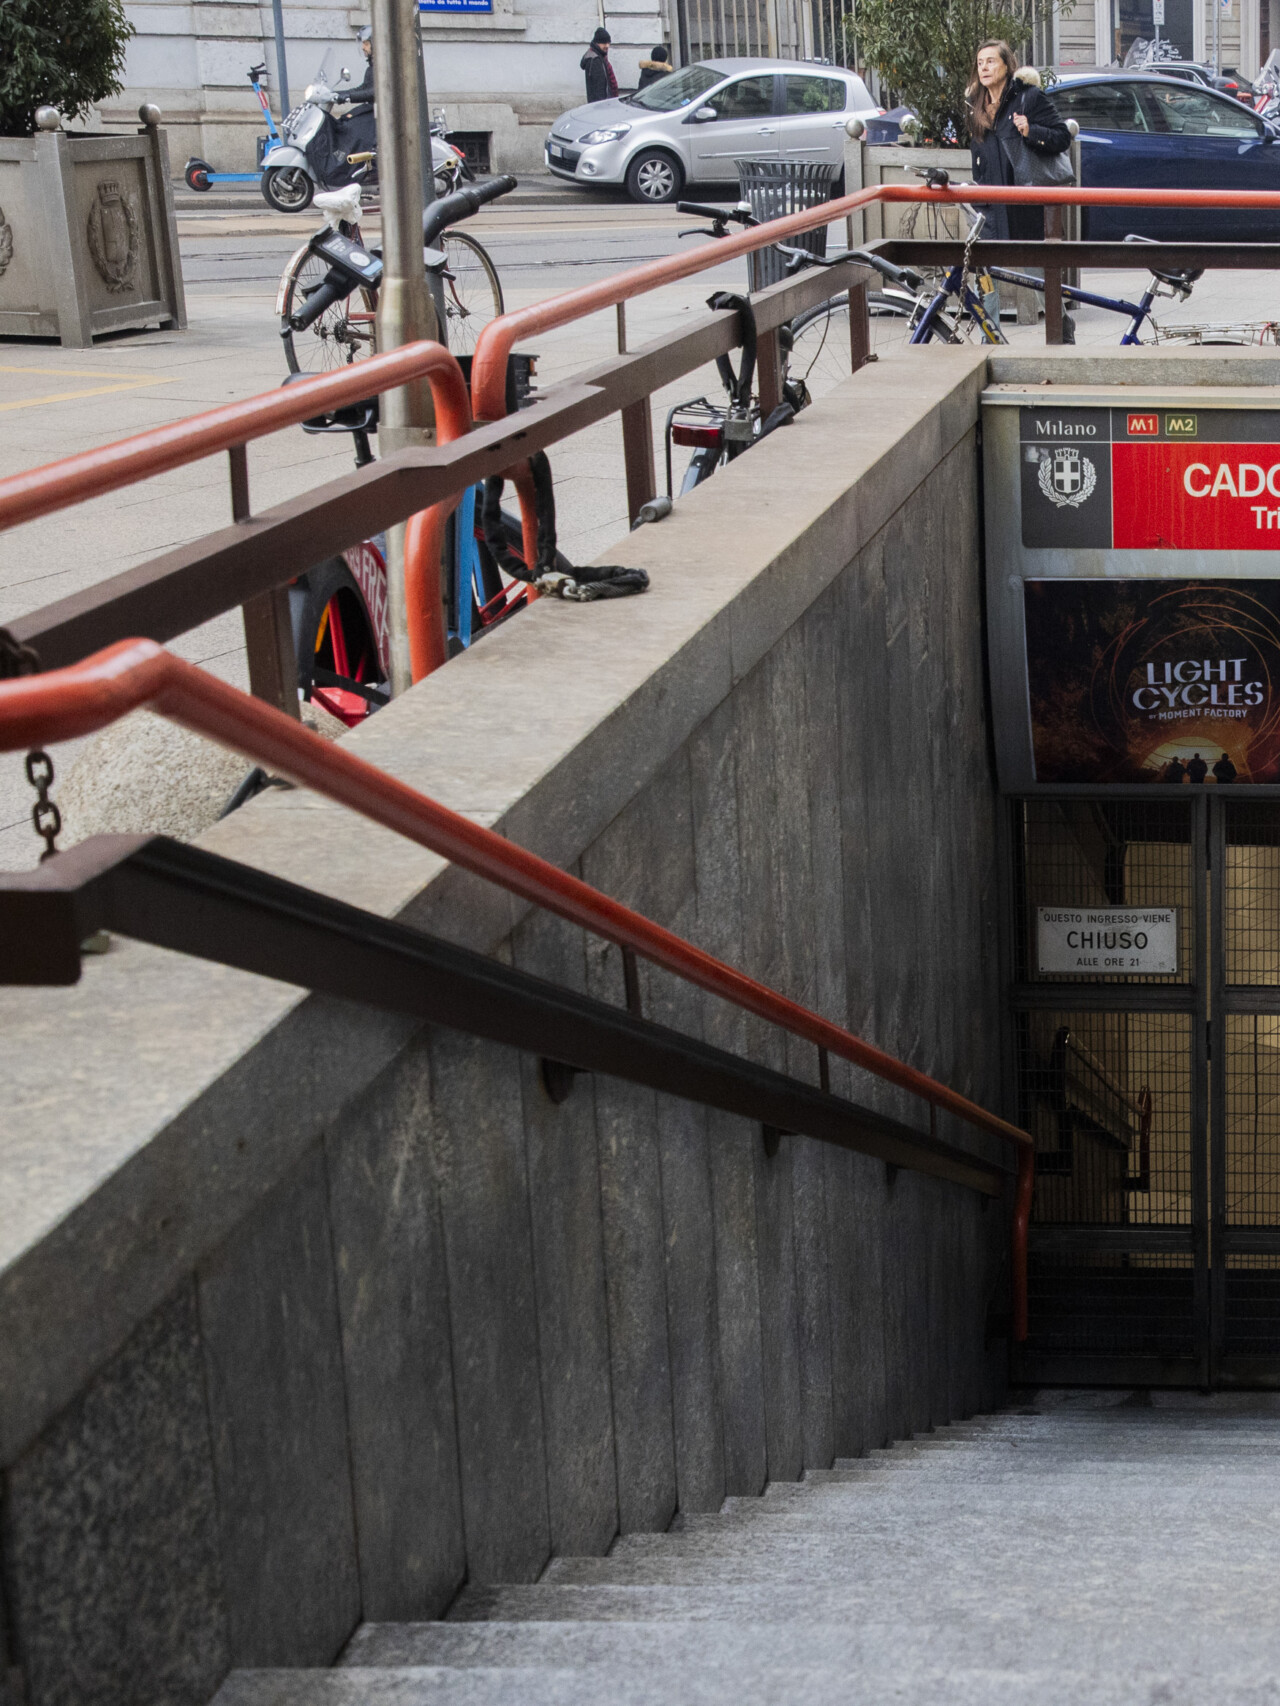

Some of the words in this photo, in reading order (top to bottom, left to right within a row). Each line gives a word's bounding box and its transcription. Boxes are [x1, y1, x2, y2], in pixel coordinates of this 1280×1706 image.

[1035, 420, 1097, 436] Milano
[1130, 418, 1154, 431] M1
[1168, 419, 1193, 431] M2
[1147, 658, 1247, 685] LIGHT
[1132, 681, 1264, 710] CYCLES
[1159, 708, 1202, 720] MOMENT
[1204, 708, 1248, 718] FACTORY
[1044, 913, 1082, 923] QUESTO
[1087, 914, 1138, 924] INGRESSO
[1143, 914, 1171, 923] VIENE
[1067, 931, 1148, 950] CHIUSO
[1076, 957, 1098, 966] ALLE
[1104, 958, 1124, 966] ORE
[1130, 958, 1140, 966] 21
